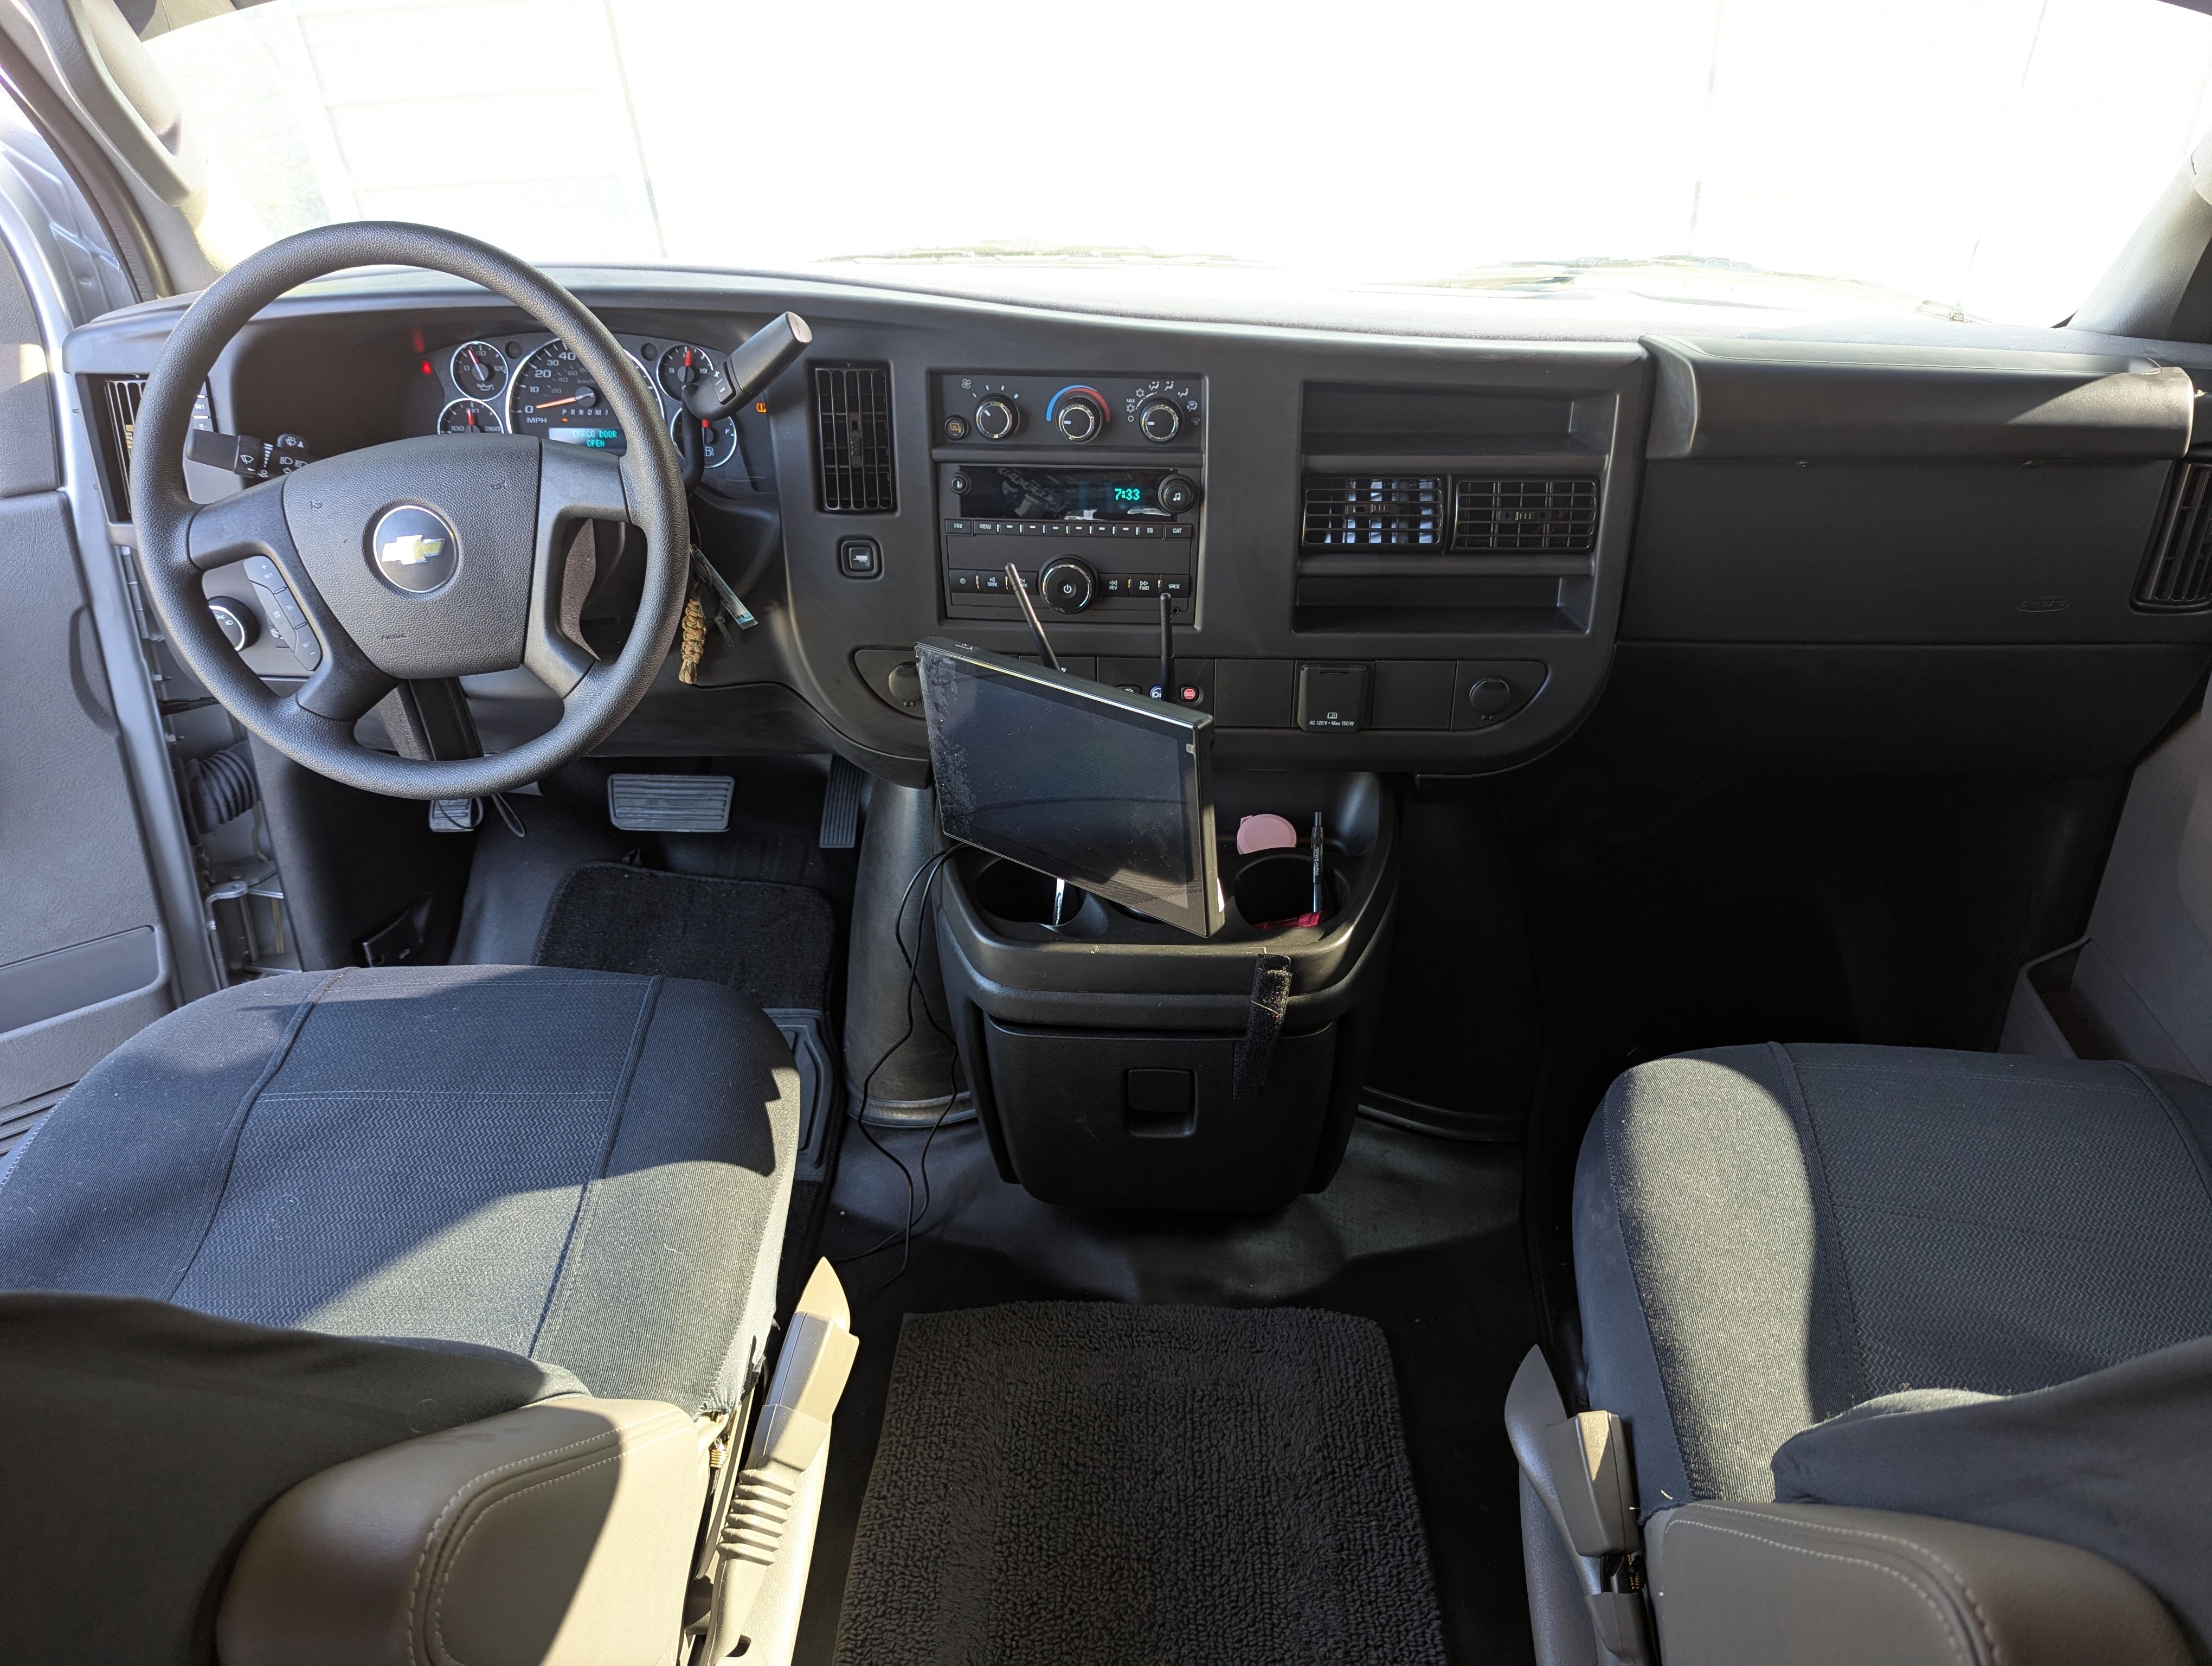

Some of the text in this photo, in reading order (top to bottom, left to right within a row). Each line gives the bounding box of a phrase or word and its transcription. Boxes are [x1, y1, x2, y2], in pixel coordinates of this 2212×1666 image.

[558, 352, 576, 361] 40
[535, 370, 551, 378] 20
[573, 430, 618, 438] CARGO DOOR
[587, 439, 606, 447] OPEN
[1115, 488, 1140, 500] 7:33
